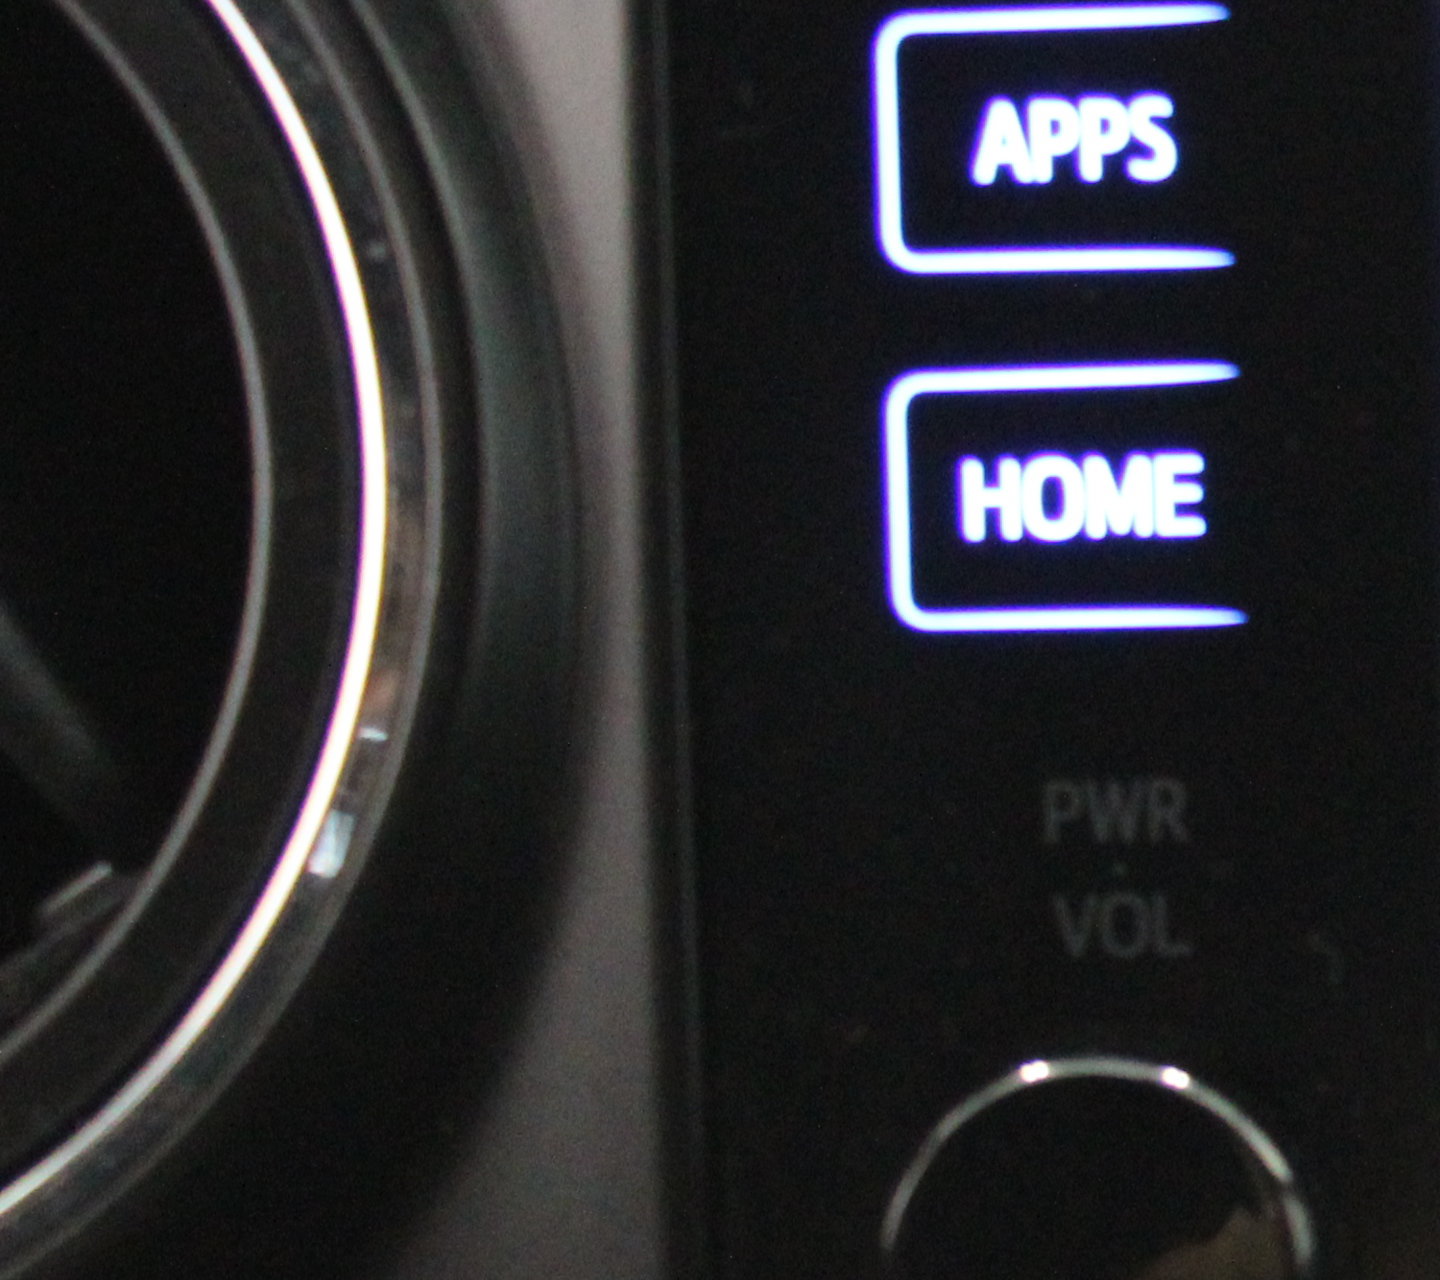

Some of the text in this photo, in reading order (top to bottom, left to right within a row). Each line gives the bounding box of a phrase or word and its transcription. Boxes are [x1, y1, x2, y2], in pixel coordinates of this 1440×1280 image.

[973, 94, 1177, 184] APPS
[961, 453, 1206, 542] HOME
[1043, 777, 1192, 845] PWR
[1051, 891, 1194, 960] VOL
